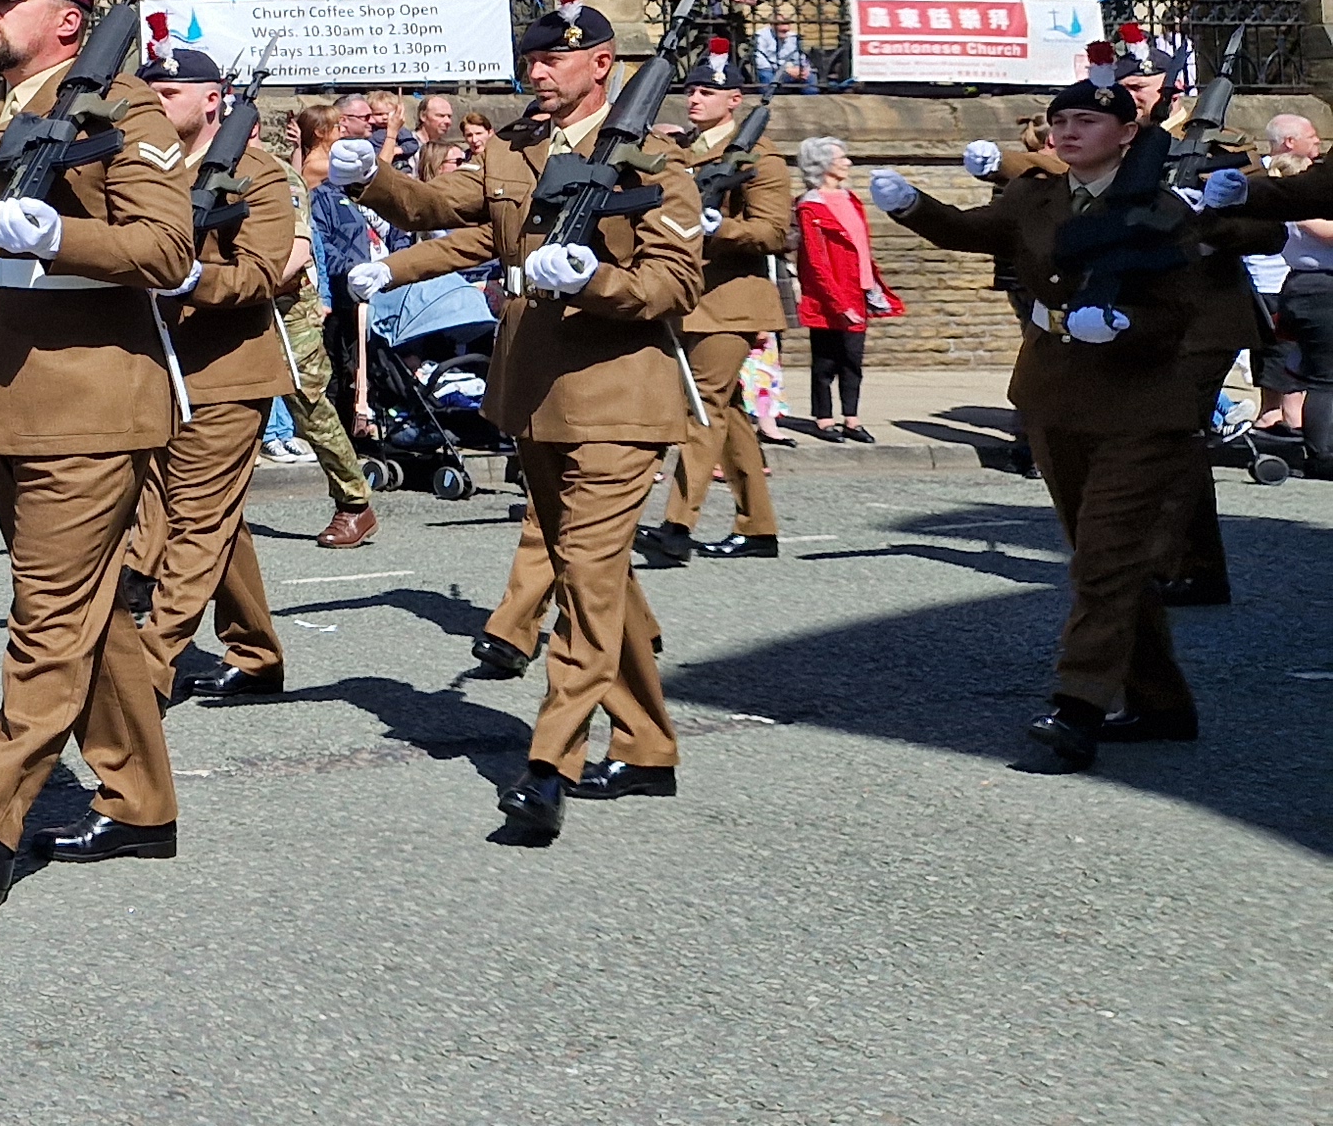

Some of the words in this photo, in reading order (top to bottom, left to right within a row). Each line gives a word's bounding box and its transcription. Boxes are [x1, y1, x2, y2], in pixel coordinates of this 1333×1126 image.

[252, 6, 305, 20] Church
[309, 5, 355, 19] Coffee
[359, 4, 395, 19] Shop
[399, 4, 439, 19] Open
[252, 25, 299, 38] Weds.
[304, 24, 365, 37] 10.30am
[369, 25, 383, 36] to
[388, 23, 443, 36] 2.30pm
[250, 44, 303, 60] Frdays
[307, 43, 368, 57] 11.30am
[373, 44, 388, 55] to
[393, 42, 447, 56] 1.30pm
[866, 41, 962, 55] Cantonese
[965, 42, 1021, 57] Church
[325, 63, 386, 75] concerts
[391, 61, 430, 74] 12.30
